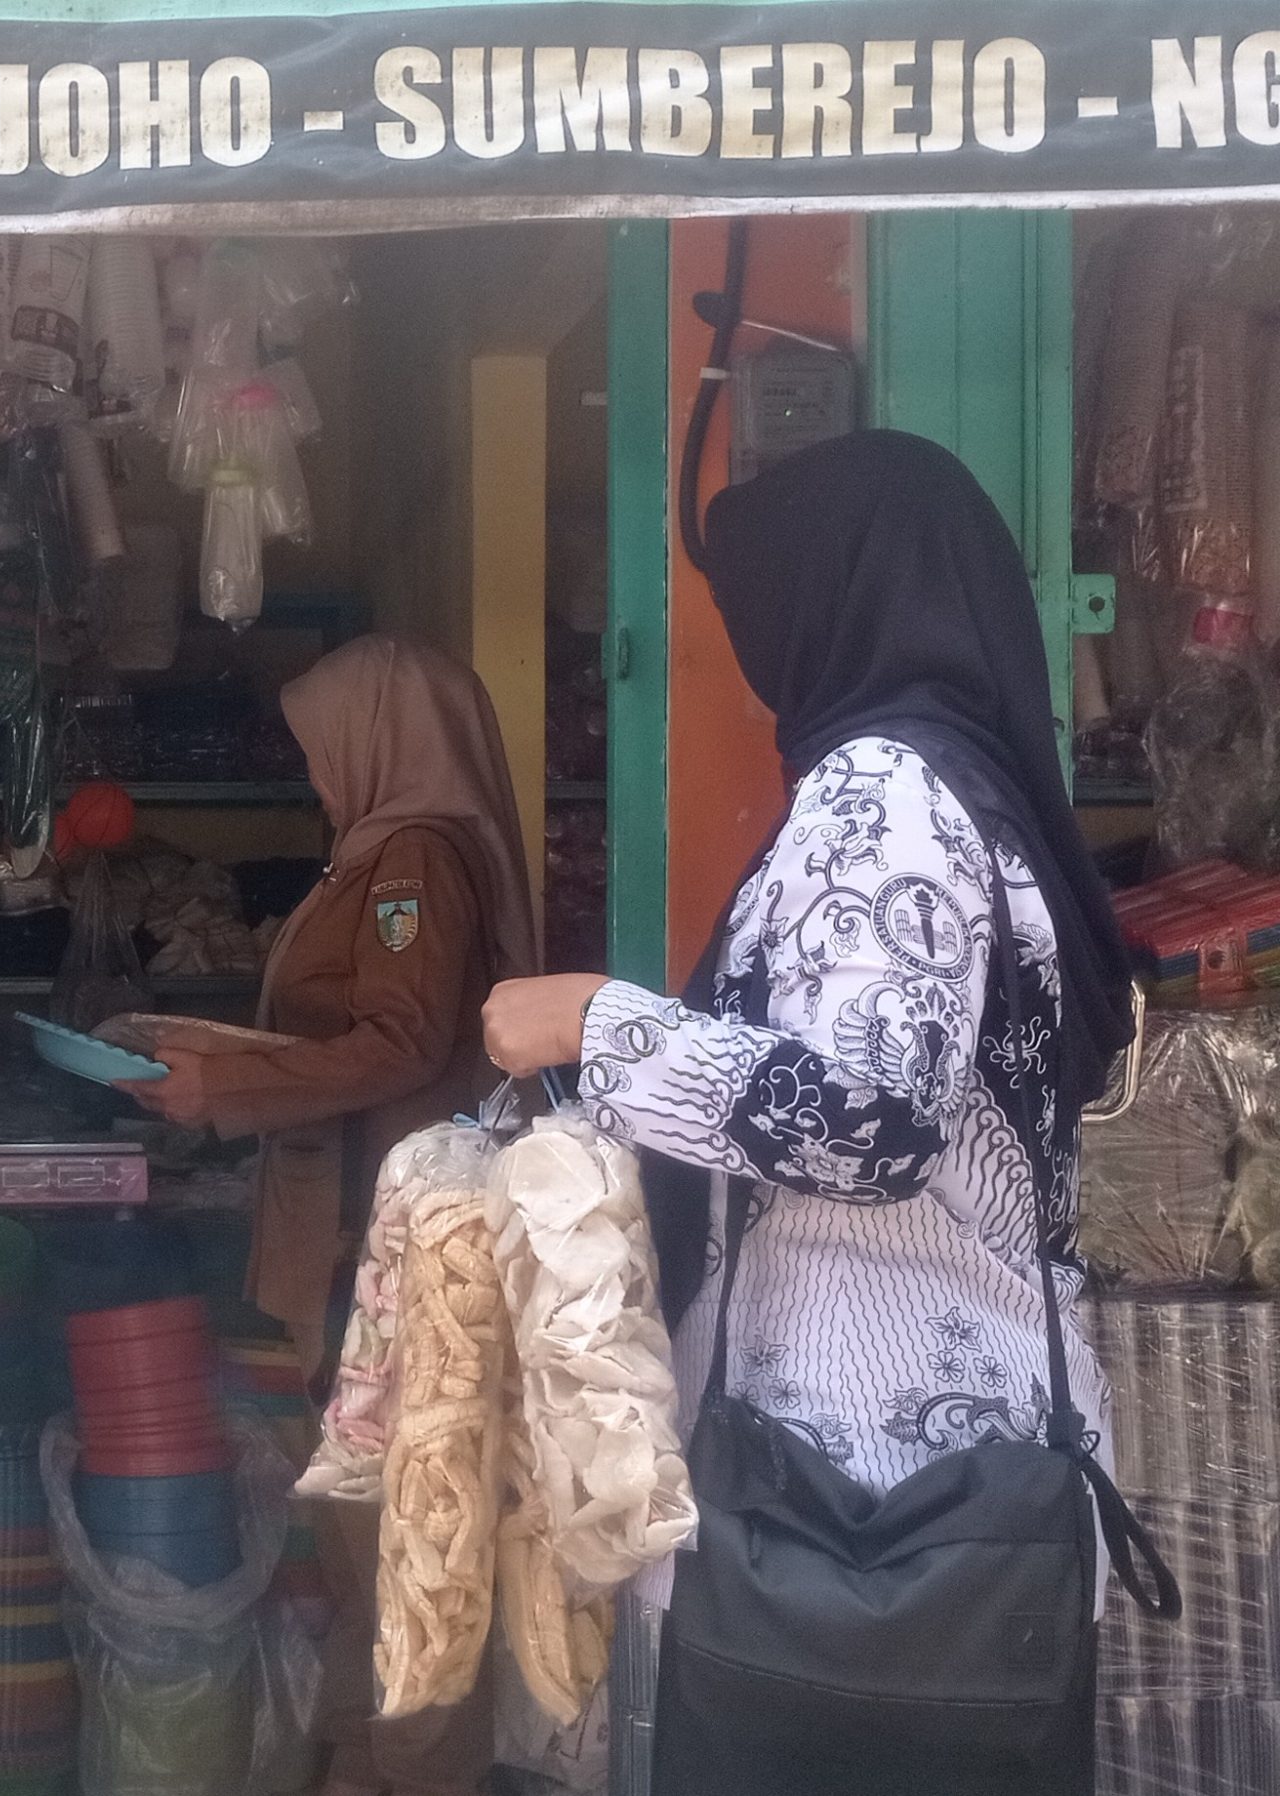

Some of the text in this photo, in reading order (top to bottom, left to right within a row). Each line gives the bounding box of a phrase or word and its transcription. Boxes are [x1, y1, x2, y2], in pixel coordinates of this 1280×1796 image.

[303, 110, 344, 133] -
[373, 37, 1047, 161] SUMBEREJO
[1078, 96, 1120, 119] -
